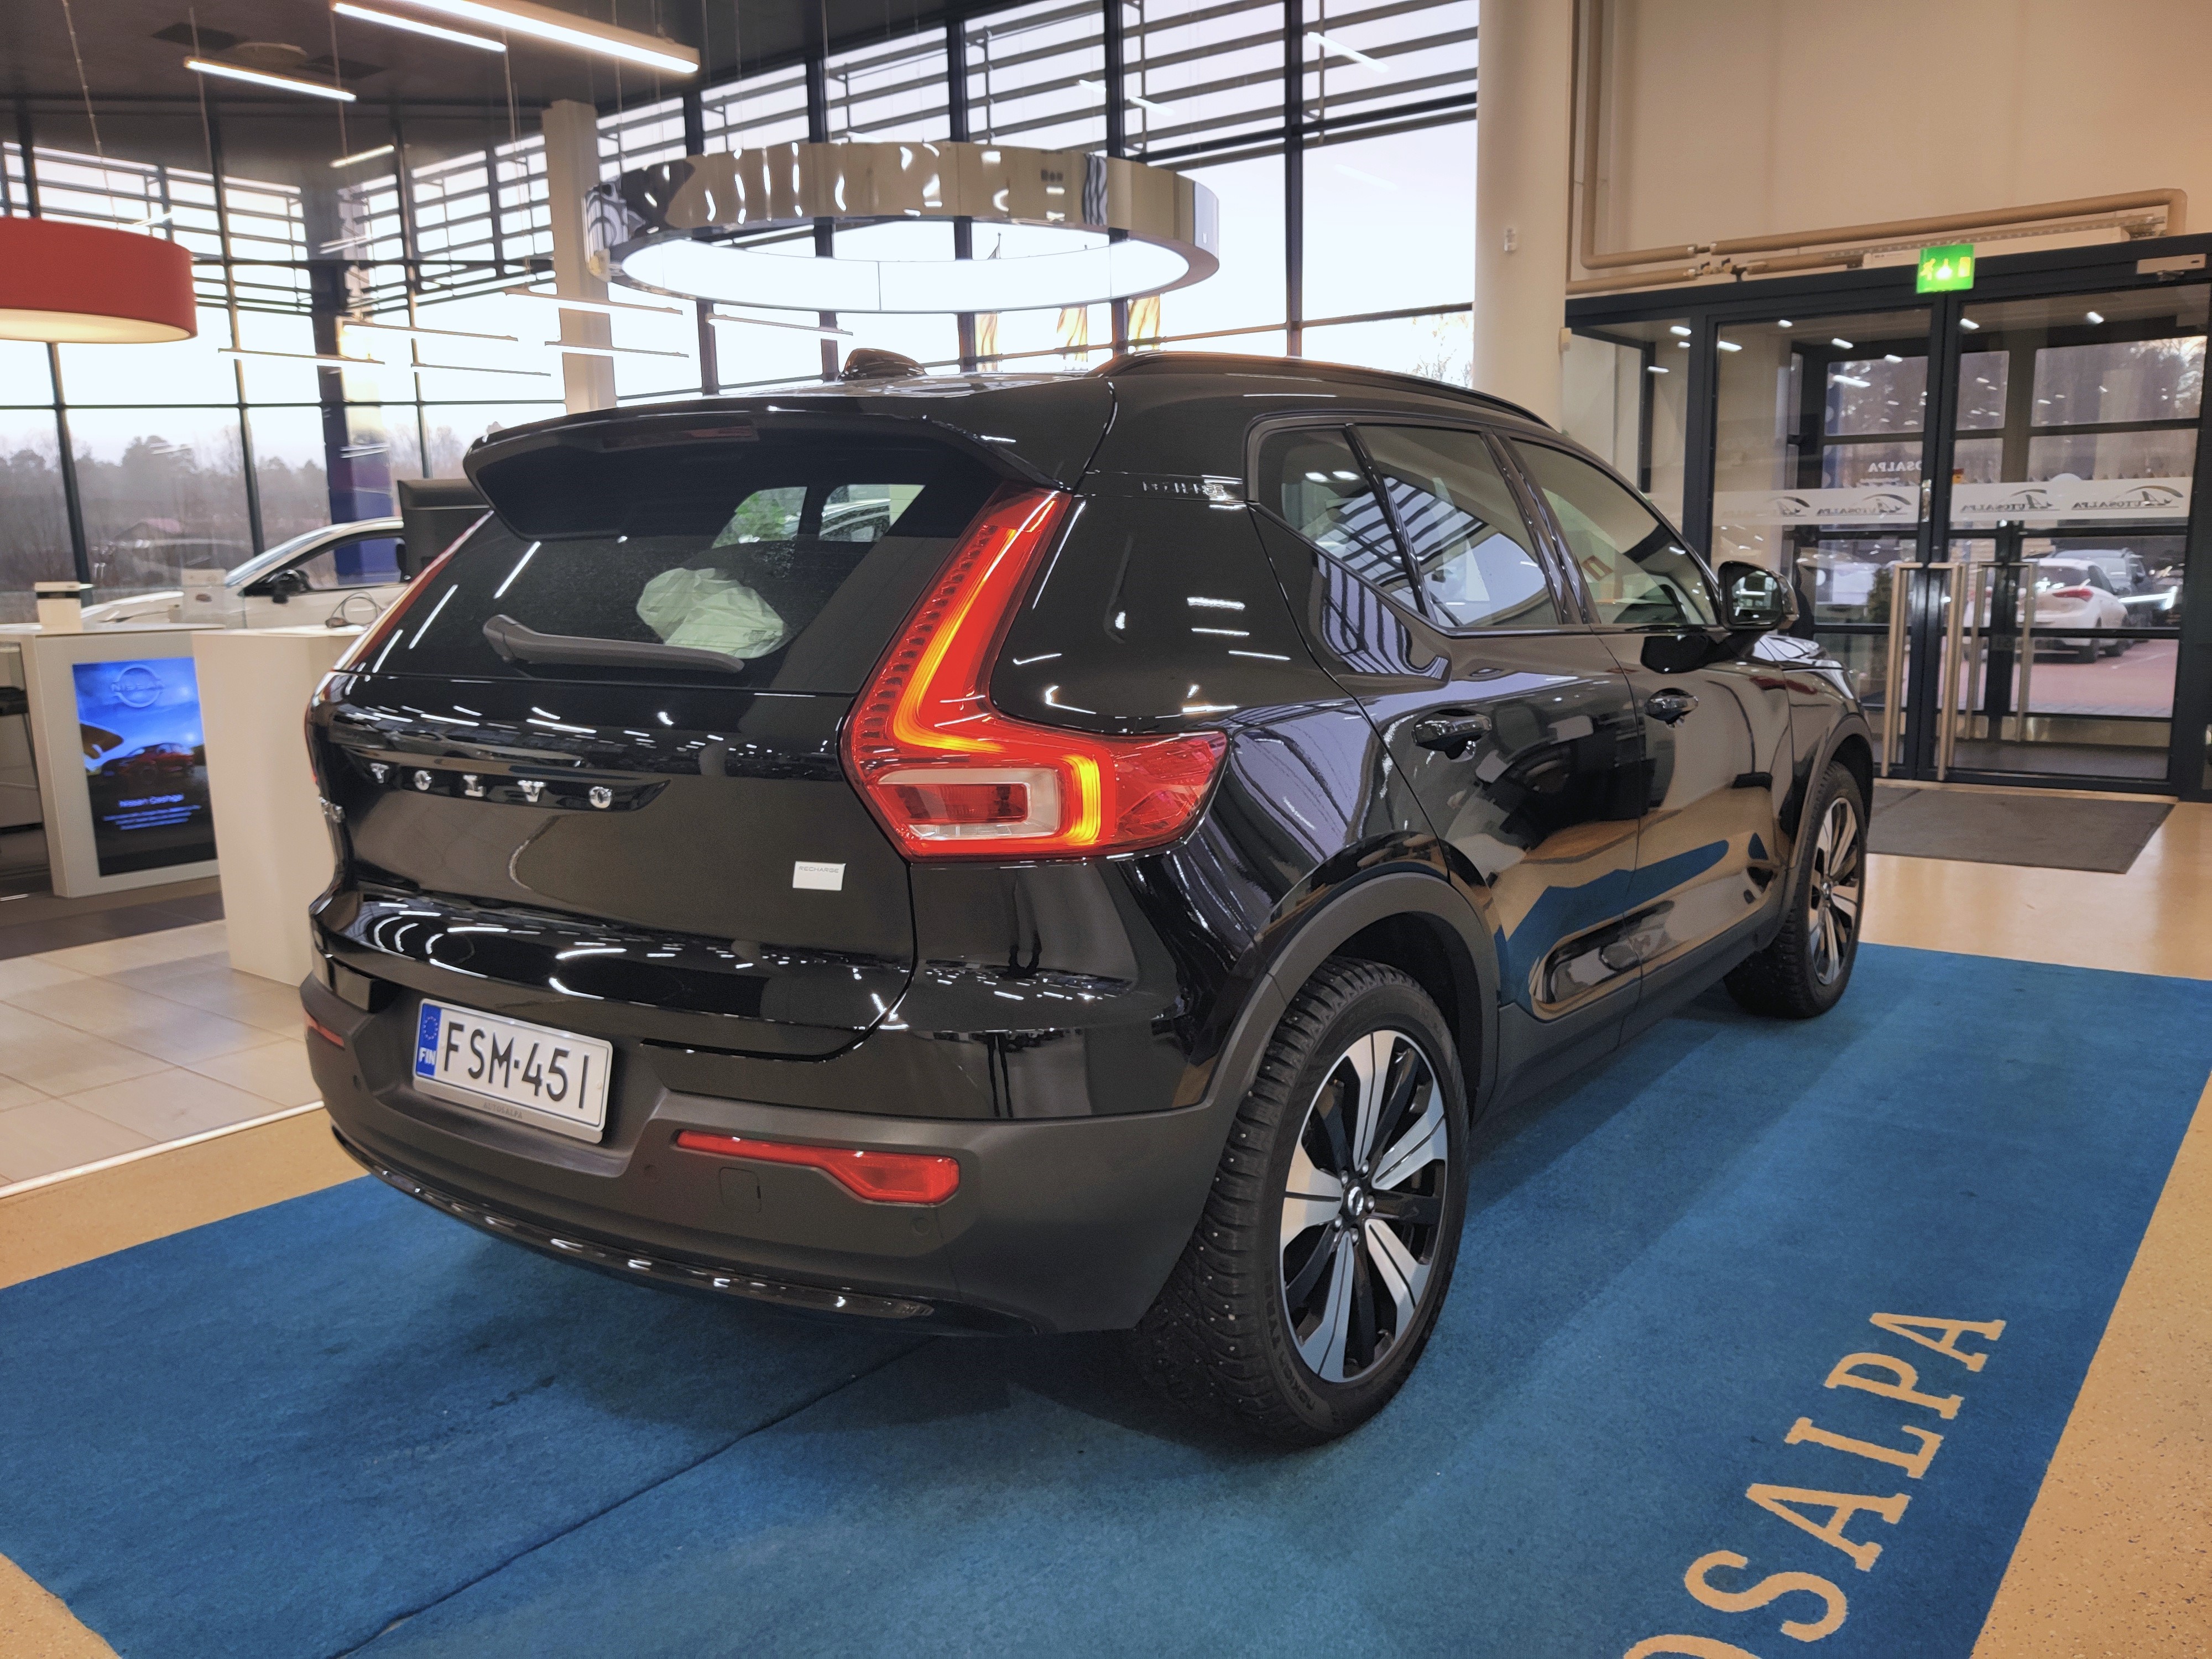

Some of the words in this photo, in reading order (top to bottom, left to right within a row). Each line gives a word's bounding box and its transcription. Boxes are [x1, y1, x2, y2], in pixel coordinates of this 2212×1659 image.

[370, 763, 612, 809] VOLVO
[419, 1047, 436, 1065] FIN
[444, 1021, 590, 1109] FSM-451
